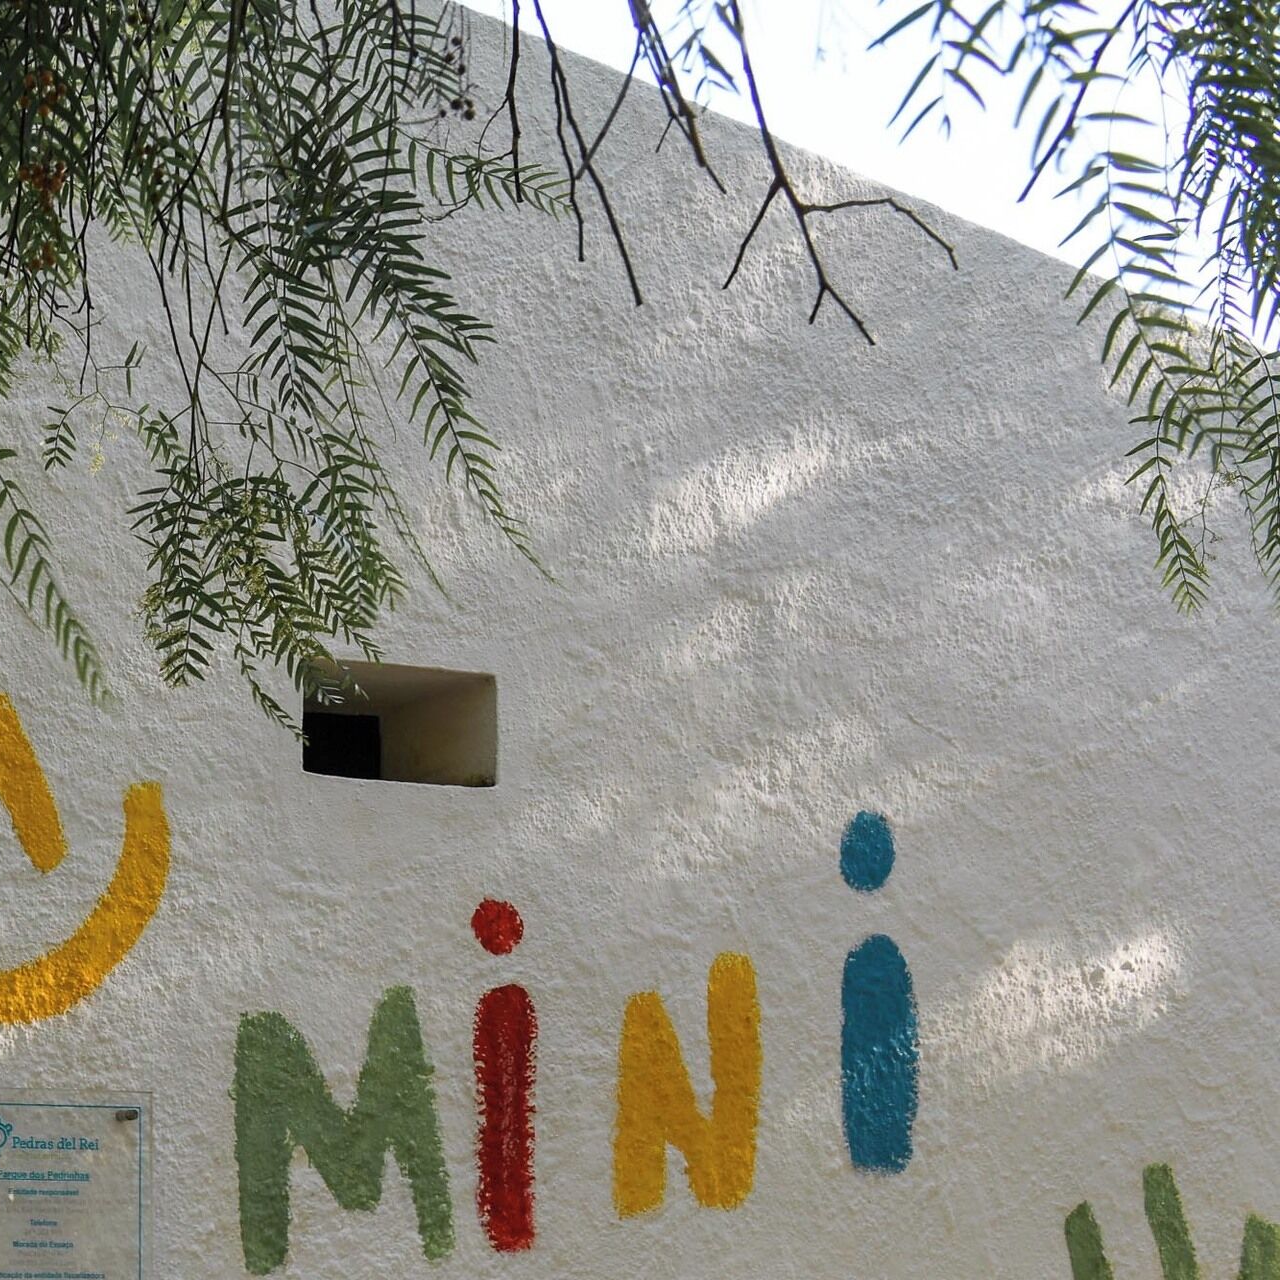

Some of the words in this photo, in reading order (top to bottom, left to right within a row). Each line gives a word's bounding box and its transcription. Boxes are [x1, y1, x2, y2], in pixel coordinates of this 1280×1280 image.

[12, 1136, 53, 1149] Pedras
[80, 1138, 99, 1150] Rei
[30, 1170, 44, 1180] dos
[47, 1170, 89, 1180] Pedrinhas
